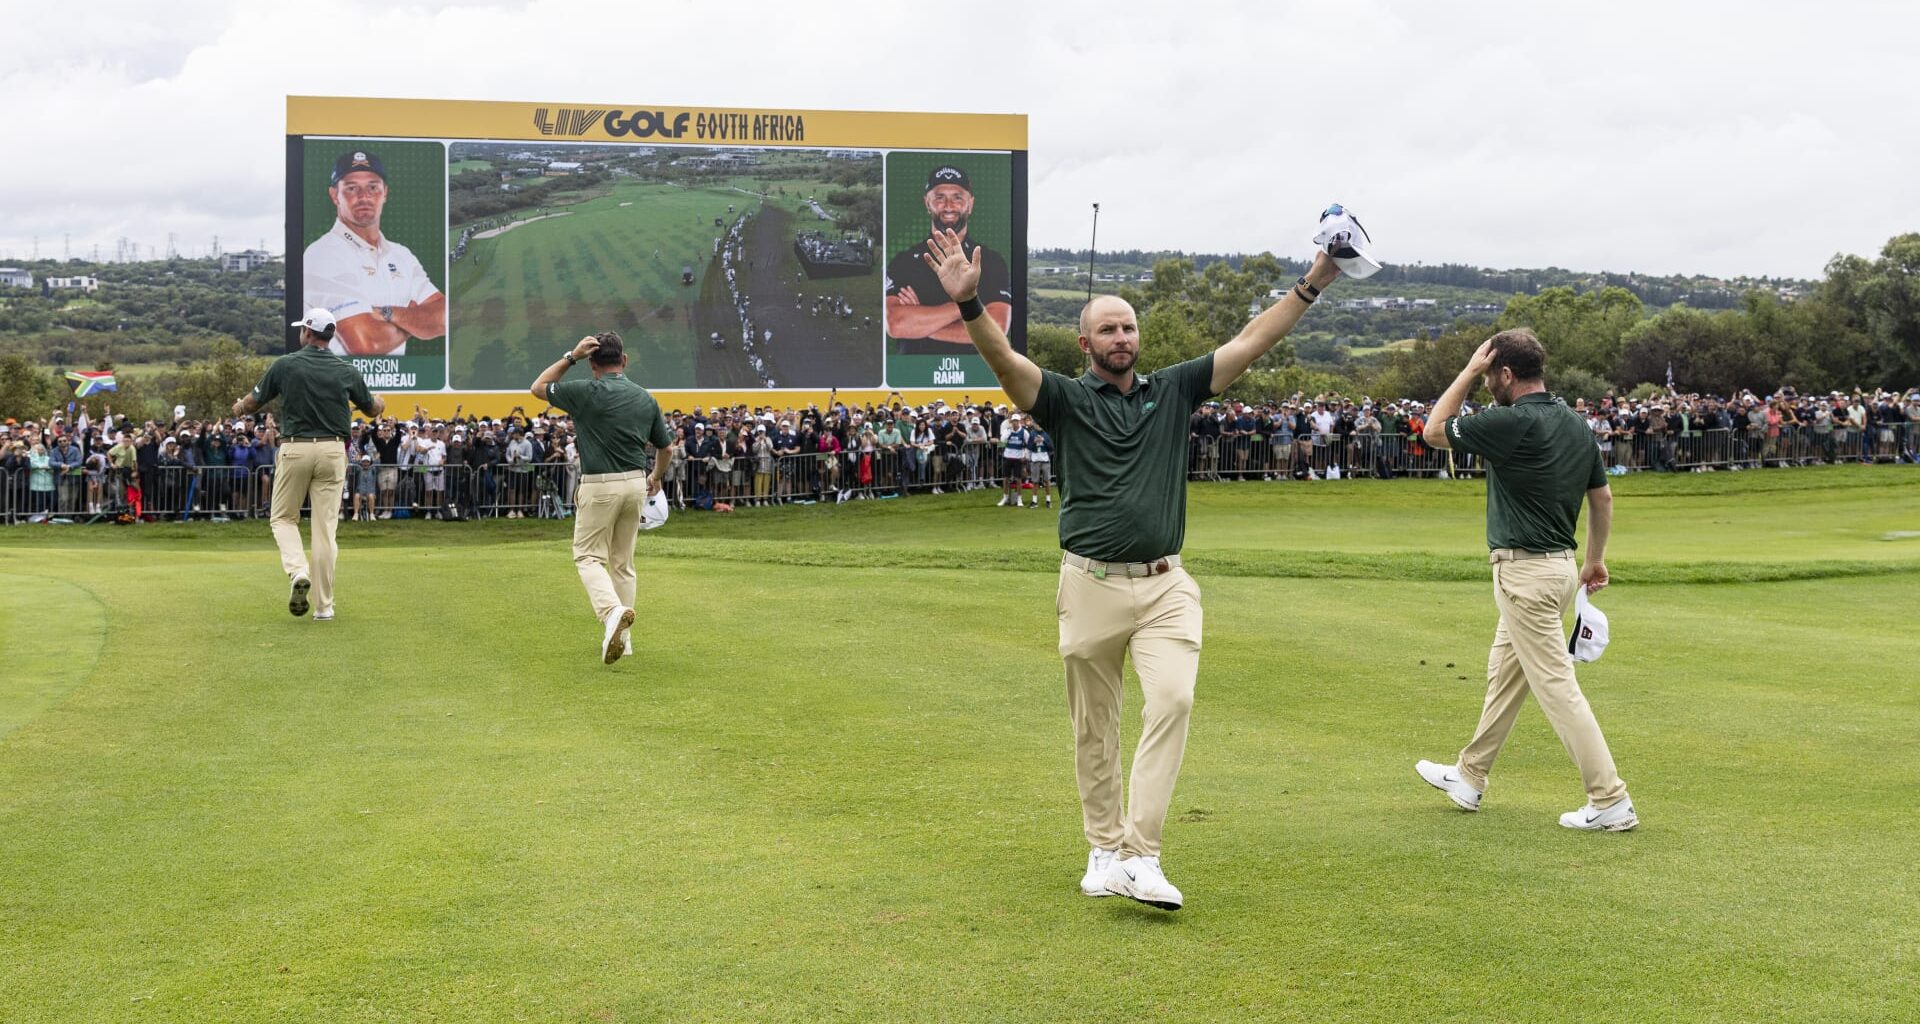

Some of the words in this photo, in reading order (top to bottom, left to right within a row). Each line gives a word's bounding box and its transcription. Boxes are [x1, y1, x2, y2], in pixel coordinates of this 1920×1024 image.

[534, 108, 606, 136] LIV
[603, 110, 690, 138] GOLF
[696, 112, 748, 140] SOUTH
[753, 114, 804, 141] AFRICA
[352, 358, 399, 373] BRYSON
[938, 357, 960, 371] JON
[363, 372, 417, 388] AMBEAU
[933, 370, 965, 385] RAHM
